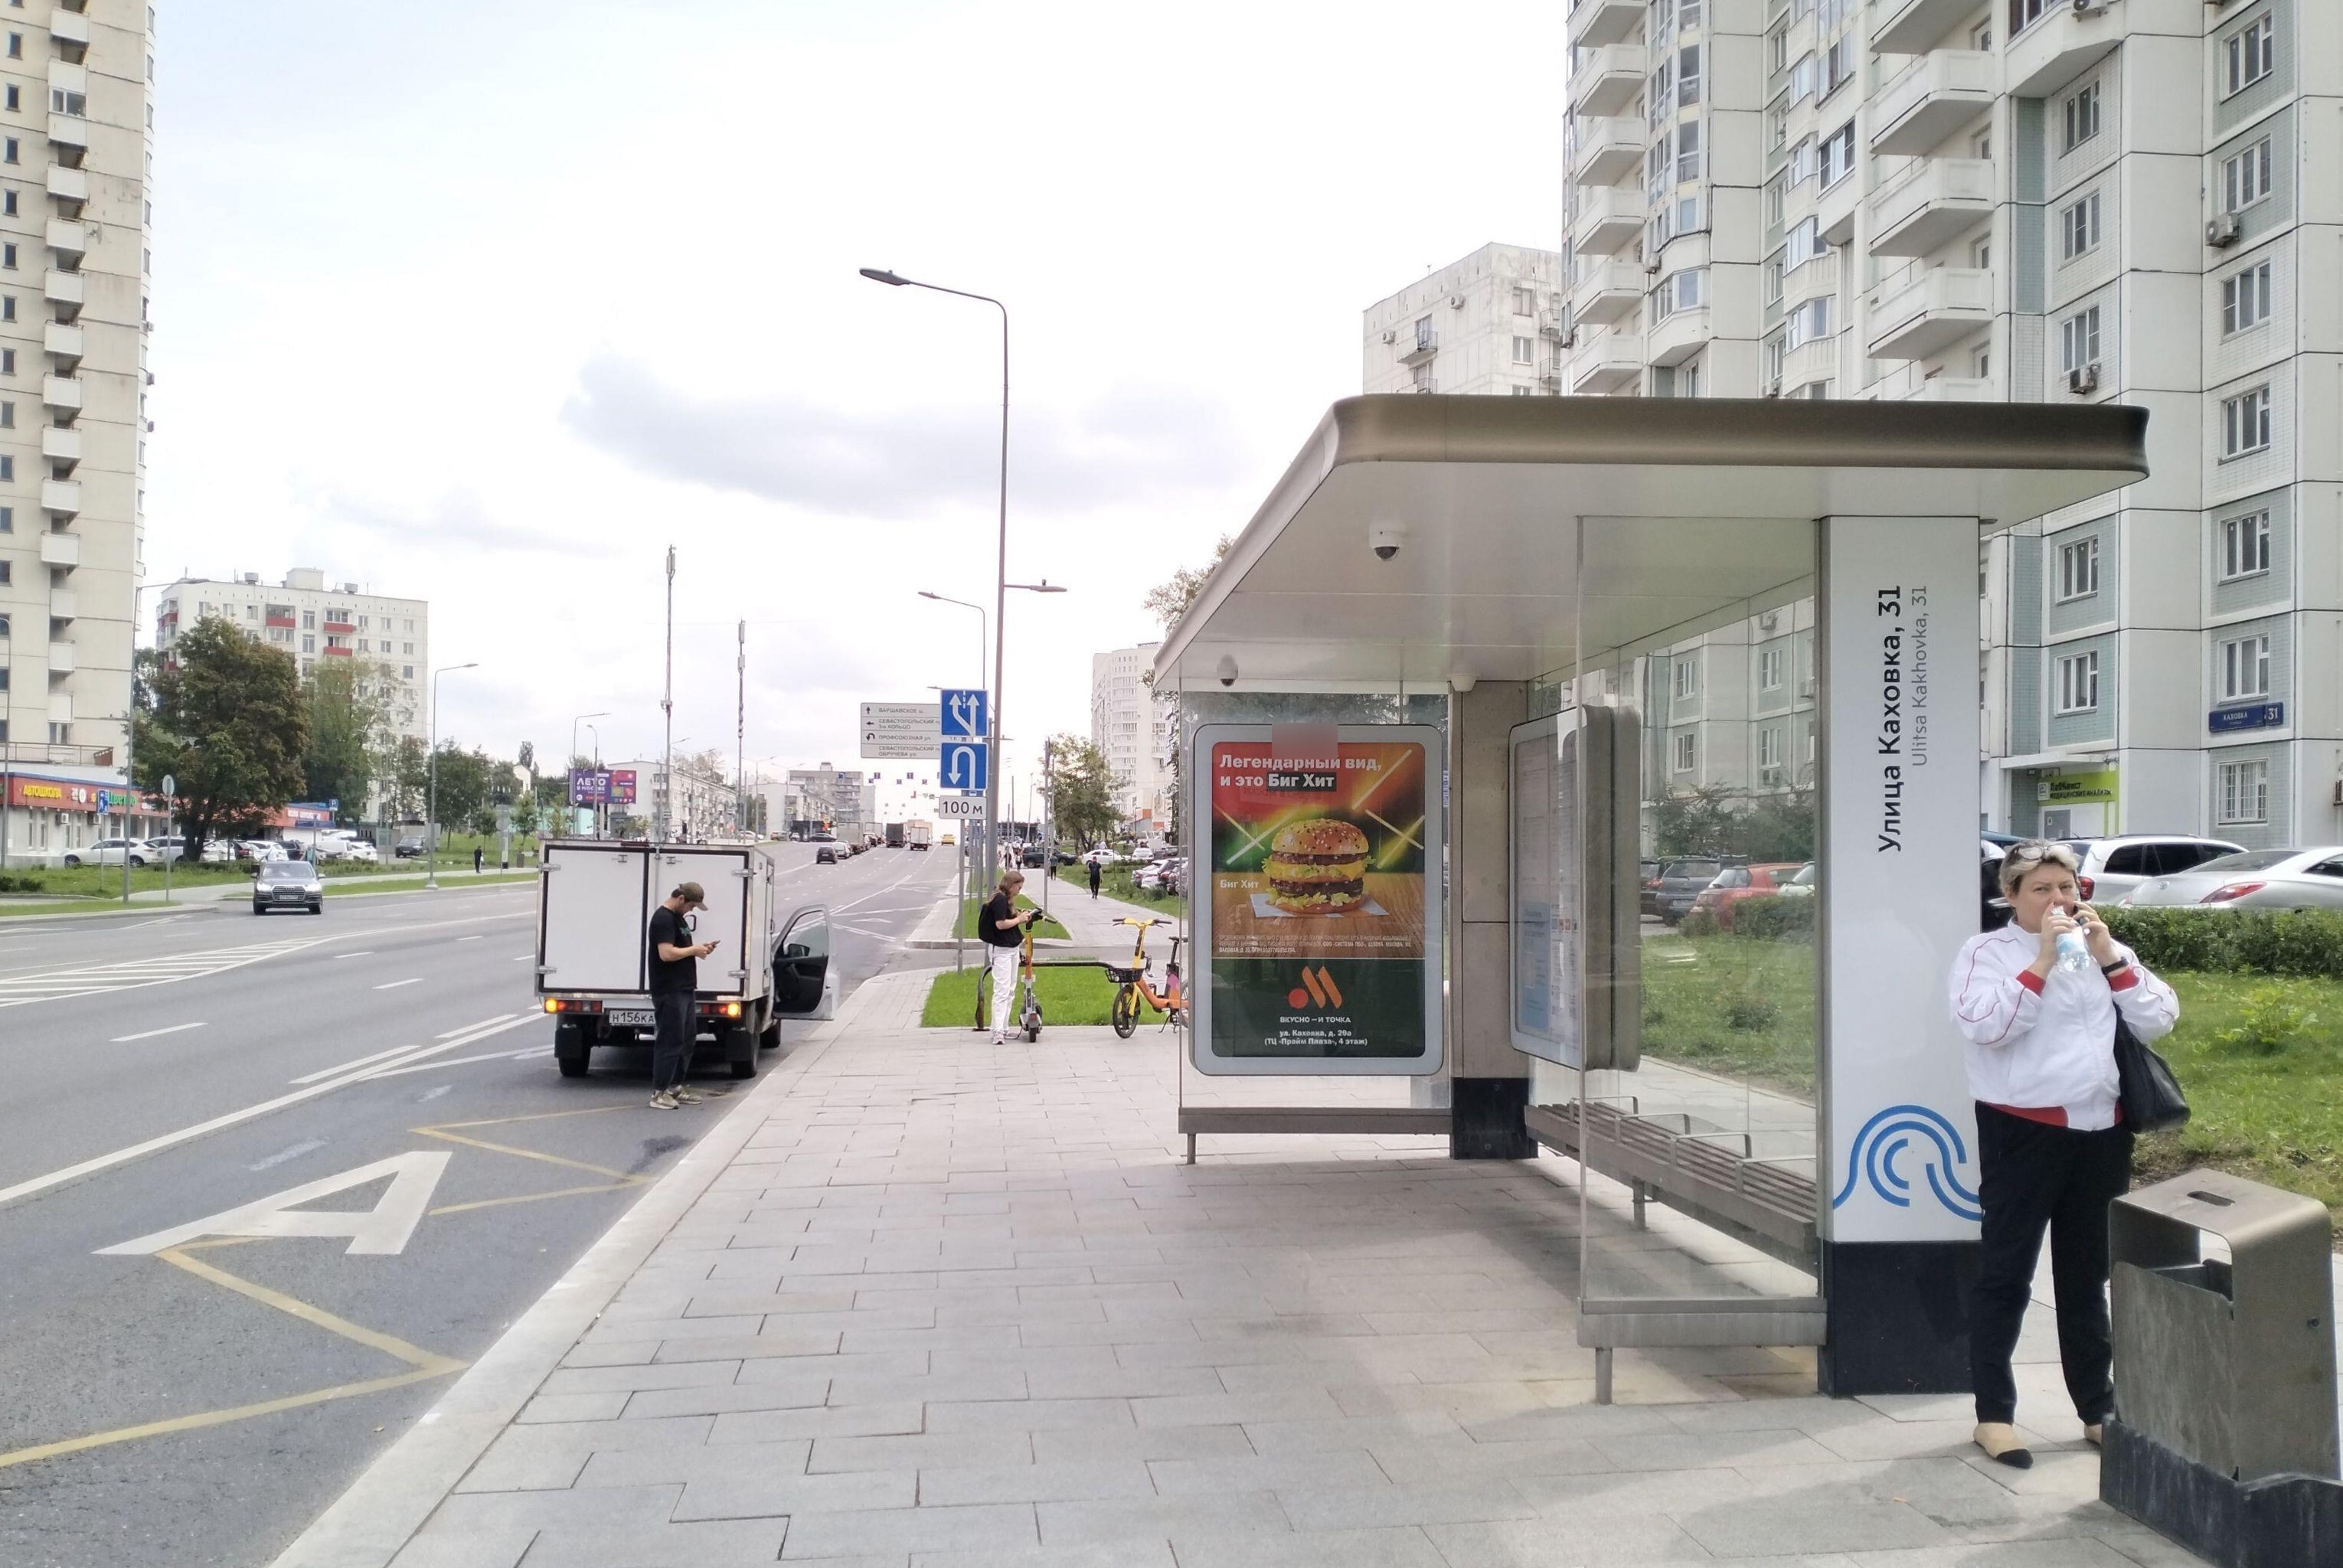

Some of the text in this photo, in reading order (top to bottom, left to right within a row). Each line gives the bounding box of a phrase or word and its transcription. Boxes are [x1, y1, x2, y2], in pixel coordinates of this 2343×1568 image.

[1911, 586, 1929, 766] Ulitsa Kakhovka, 31
[1878, 585, 1905, 852] Улица Каховка, 31
[2223, 707, 2279, 721] КАХОВКА 31
[1220, 754, 1381, 772] Легендарный вид,
[577, 777, 606, 786] ЛЕТО
[1220, 773, 1335, 787] и это Биг Хит
[943, 801, 982, 815] 100 м
[1220, 880, 1259, 888] Биг Хит
